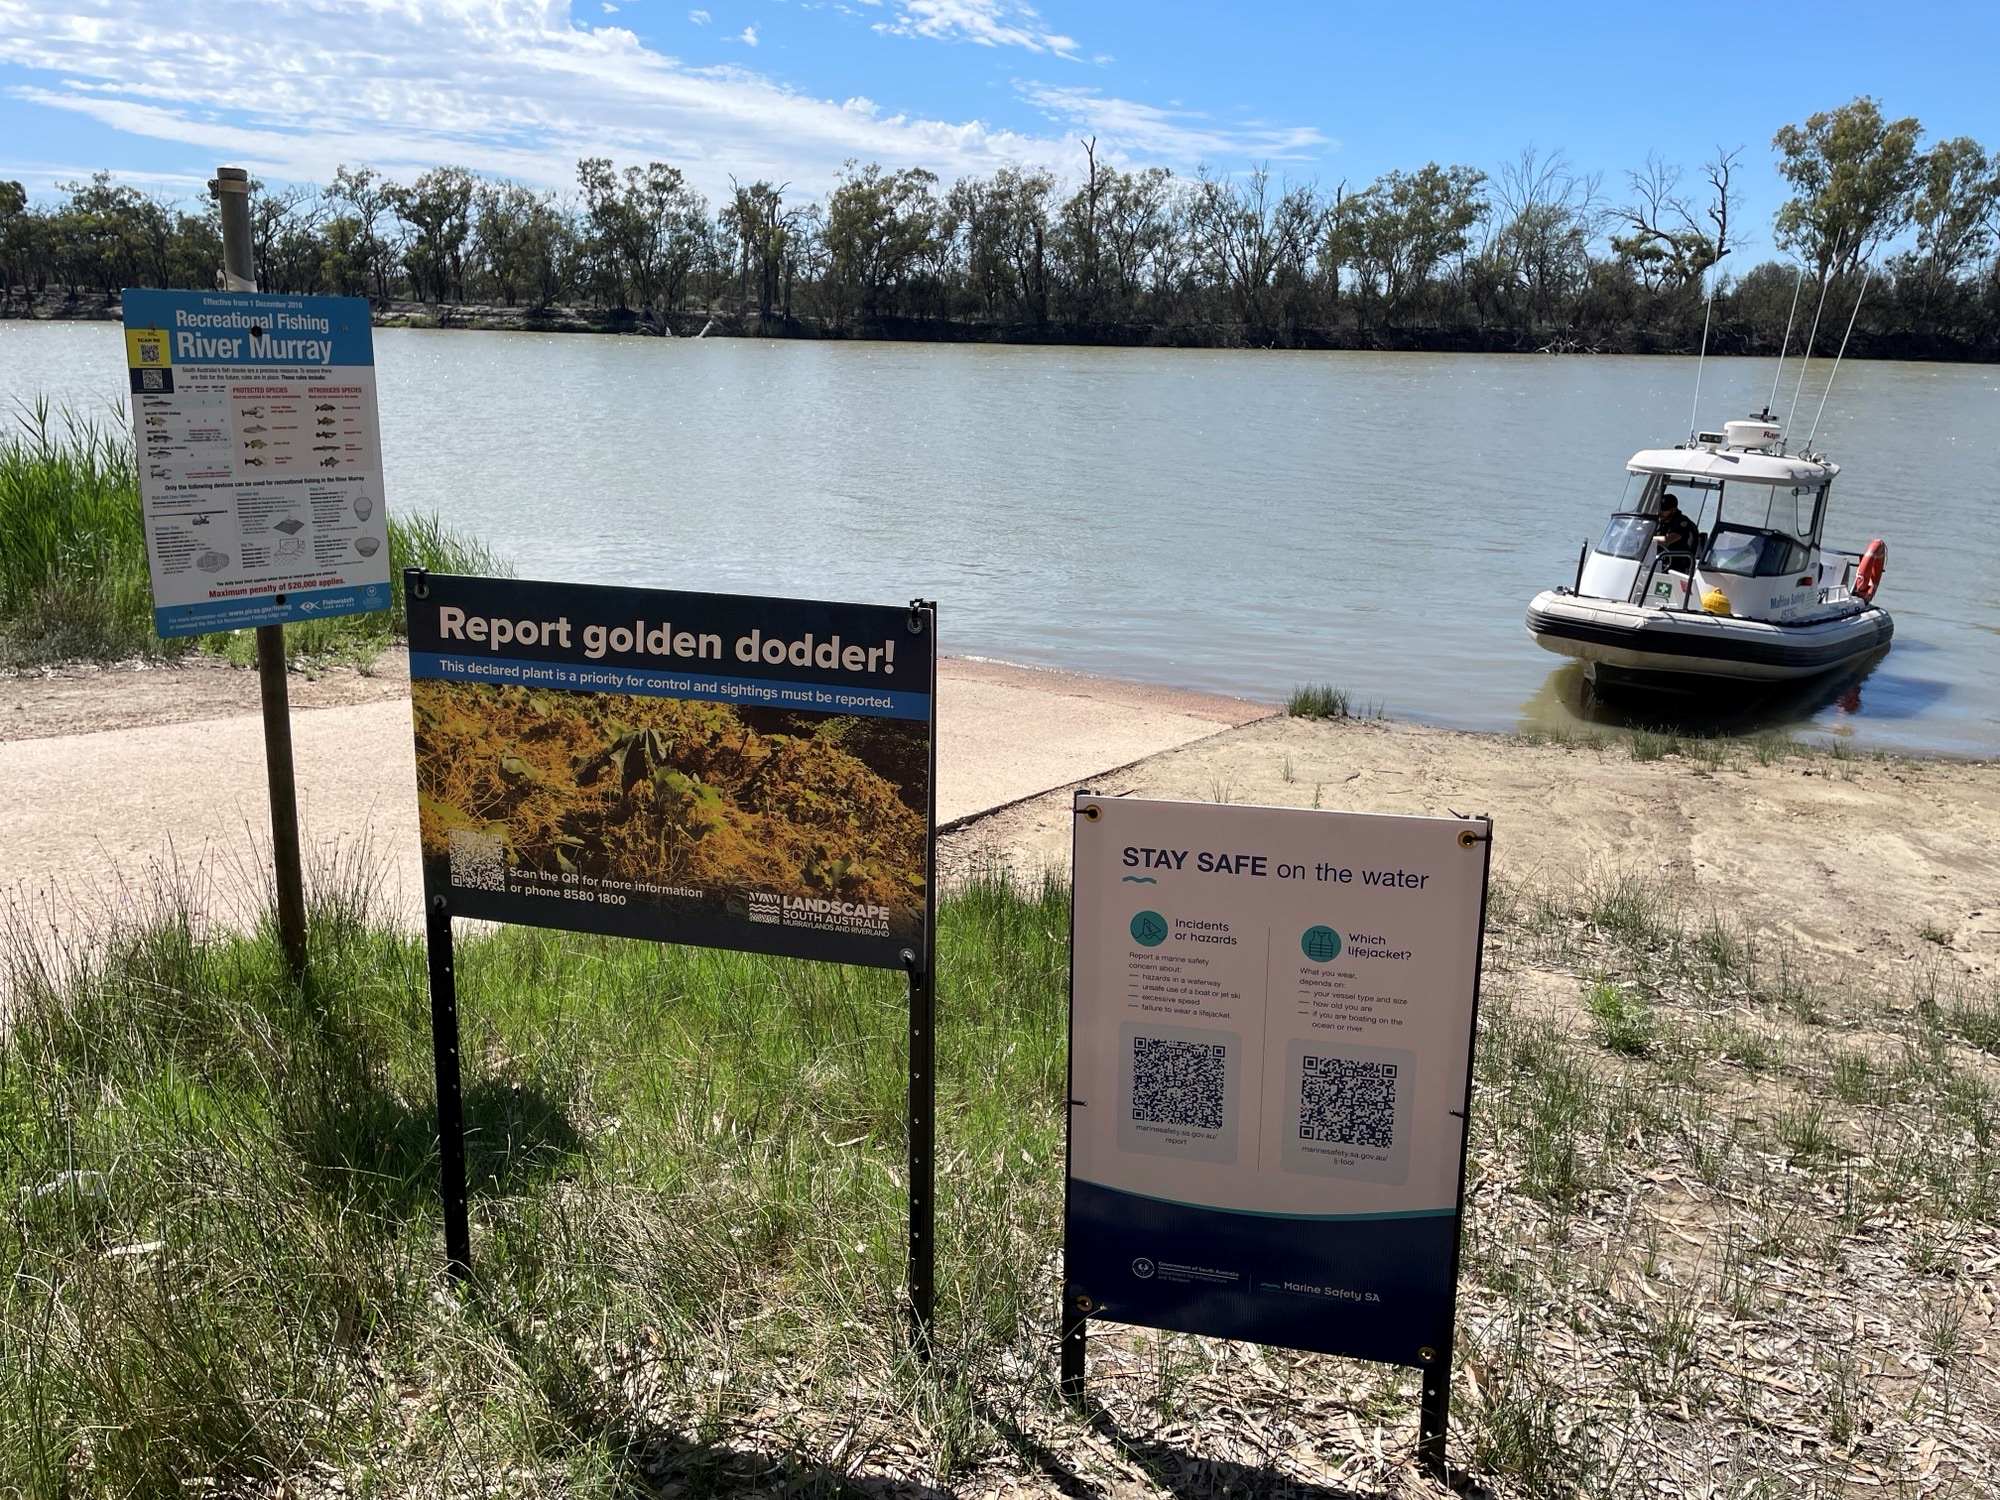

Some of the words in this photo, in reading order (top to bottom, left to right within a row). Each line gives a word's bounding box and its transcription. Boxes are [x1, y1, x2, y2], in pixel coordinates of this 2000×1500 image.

[175, 310, 274, 329] Recreational
[277, 313, 329, 334] Fishing
[177, 331, 242, 358] River
[250, 333, 332, 365] Murray
[208, 587, 248, 598] Maximum
[249, 584, 277, 596] penalty
[287, 580, 318, 590] $20,000
[318, 578, 346, 587] applies.
[439, 606, 572, 651] Report
[583, 620, 722, 659] golden
[735, 628, 895, 675] dodder!
[440, 660, 465, 673] This
[467, 661, 520, 678] declared
[522, 667, 554, 680] plant
[556, 669, 566, 681] is
[568, 673, 577, 682] a
[579, 670, 623, 688] priority
[626, 675, 643, 688] for
[647, 678, 690, 691] control
[693, 681, 717, 693] and
[720, 683, 778, 701] sightings
[781, 689, 813, 702] must
[816, 690, 832, 703] be
[835, 694, 894, 709] reported.
[1122, 846, 1189, 870] STAY
[1197, 852, 1268, 877] SAFE
[1276, 861, 1306, 880] on
[1315, 862, 1353, 884] the
[1362, 868, 1430, 890] water
[509, 867, 537, 880] Scan
[540, 870, 559, 882] the
[561, 873, 579, 885] QR
[582, 875, 599, 886] for
[601, 879, 632, 890] more
[634, 880, 703, 898] information
[510, 884, 522, 893] or
[525, 885, 561, 899] phone
[563, 890, 594, 902] 8580
[597, 893, 627, 906] 1800
[783, 895, 890, 920] LANDSCAPE
[782, 910, 822, 922] SOUTH
[825, 915, 889, 930] AUSTRALIA
[1175, 918, 1230, 932] Incidents
[783, 919, 834, 931] MURRAYLANDS
[835, 925, 850, 933] AND
[851, 927, 890, 938] RIVERLAND
[1174, 931, 1186, 941] or
[1189, 931, 1238, 946] hazards
[1348, 933, 1386, 945] Which
[1129, 951, 1153, 960] Report
[1161, 955, 1186, 963] marine
[1187, 958, 1210, 967] safety
[1348, 946, 1412, 960] lifejacket?
[1299, 967, 1320, 975] What
[1142, 973, 1171, 982] hazards
[1187, 979, 1221, 988] waterway
[1299, 979, 1332, 988] depends
[1180, 986, 1187, 994] of
[1220, 991, 1230, 999] jet
[1332, 992, 1356, 1000] vessel
[1357, 994, 1374, 1002] type
[1375, 996, 1391, 1004] and
[1141, 995, 1176, 1003] excessive
[1177, 998, 1200, 1006] speed
[1141, 1004, 1163, 1012] failure
[1311, 1022, 1335, 1030] ocean
[1336, 1023, 1344, 1031] or
[1348, 1013, 1377, 1024] boating
[1378, 1017, 1389, 1025] on
[1284, 1281, 1321, 1294] Marine
[1324, 1287, 1362, 1302] Safety
[1365, 1292, 1380, 1302] SA
